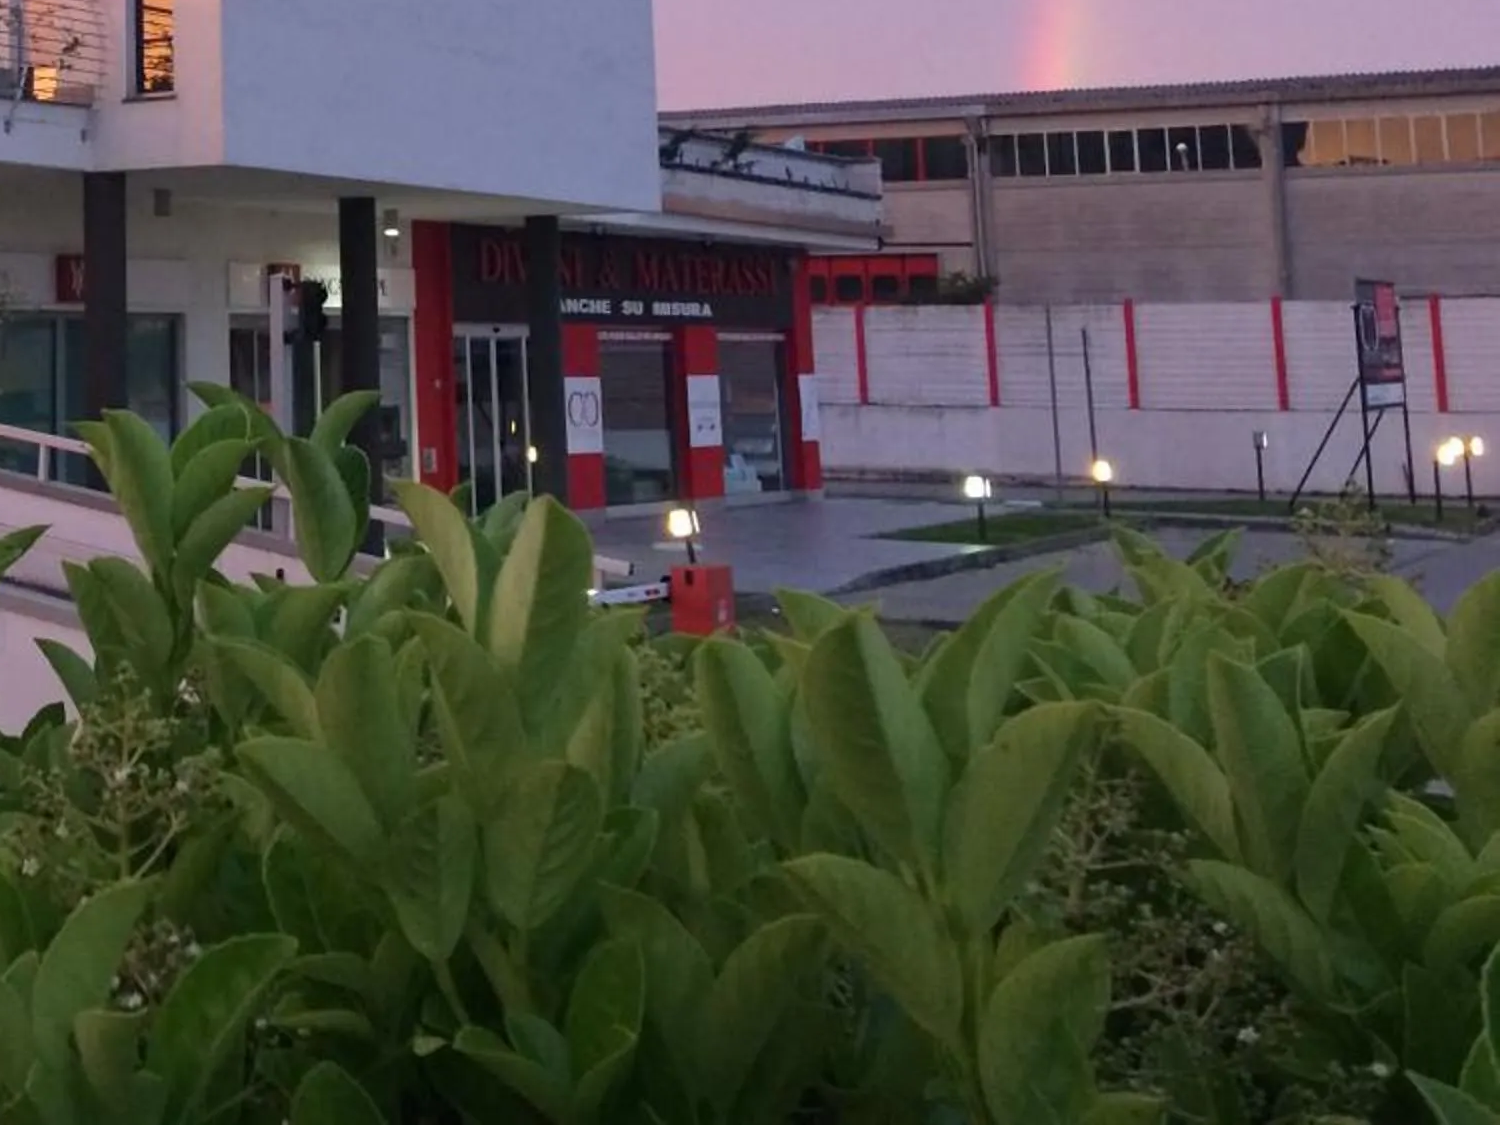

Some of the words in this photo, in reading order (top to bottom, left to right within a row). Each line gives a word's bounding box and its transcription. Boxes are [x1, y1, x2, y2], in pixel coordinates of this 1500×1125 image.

[481, 240, 582, 288] DIVNI
[636, 251, 778, 297] MATERASSI
[621, 299, 644, 316] SU
[652, 301, 714, 318] MISURA
